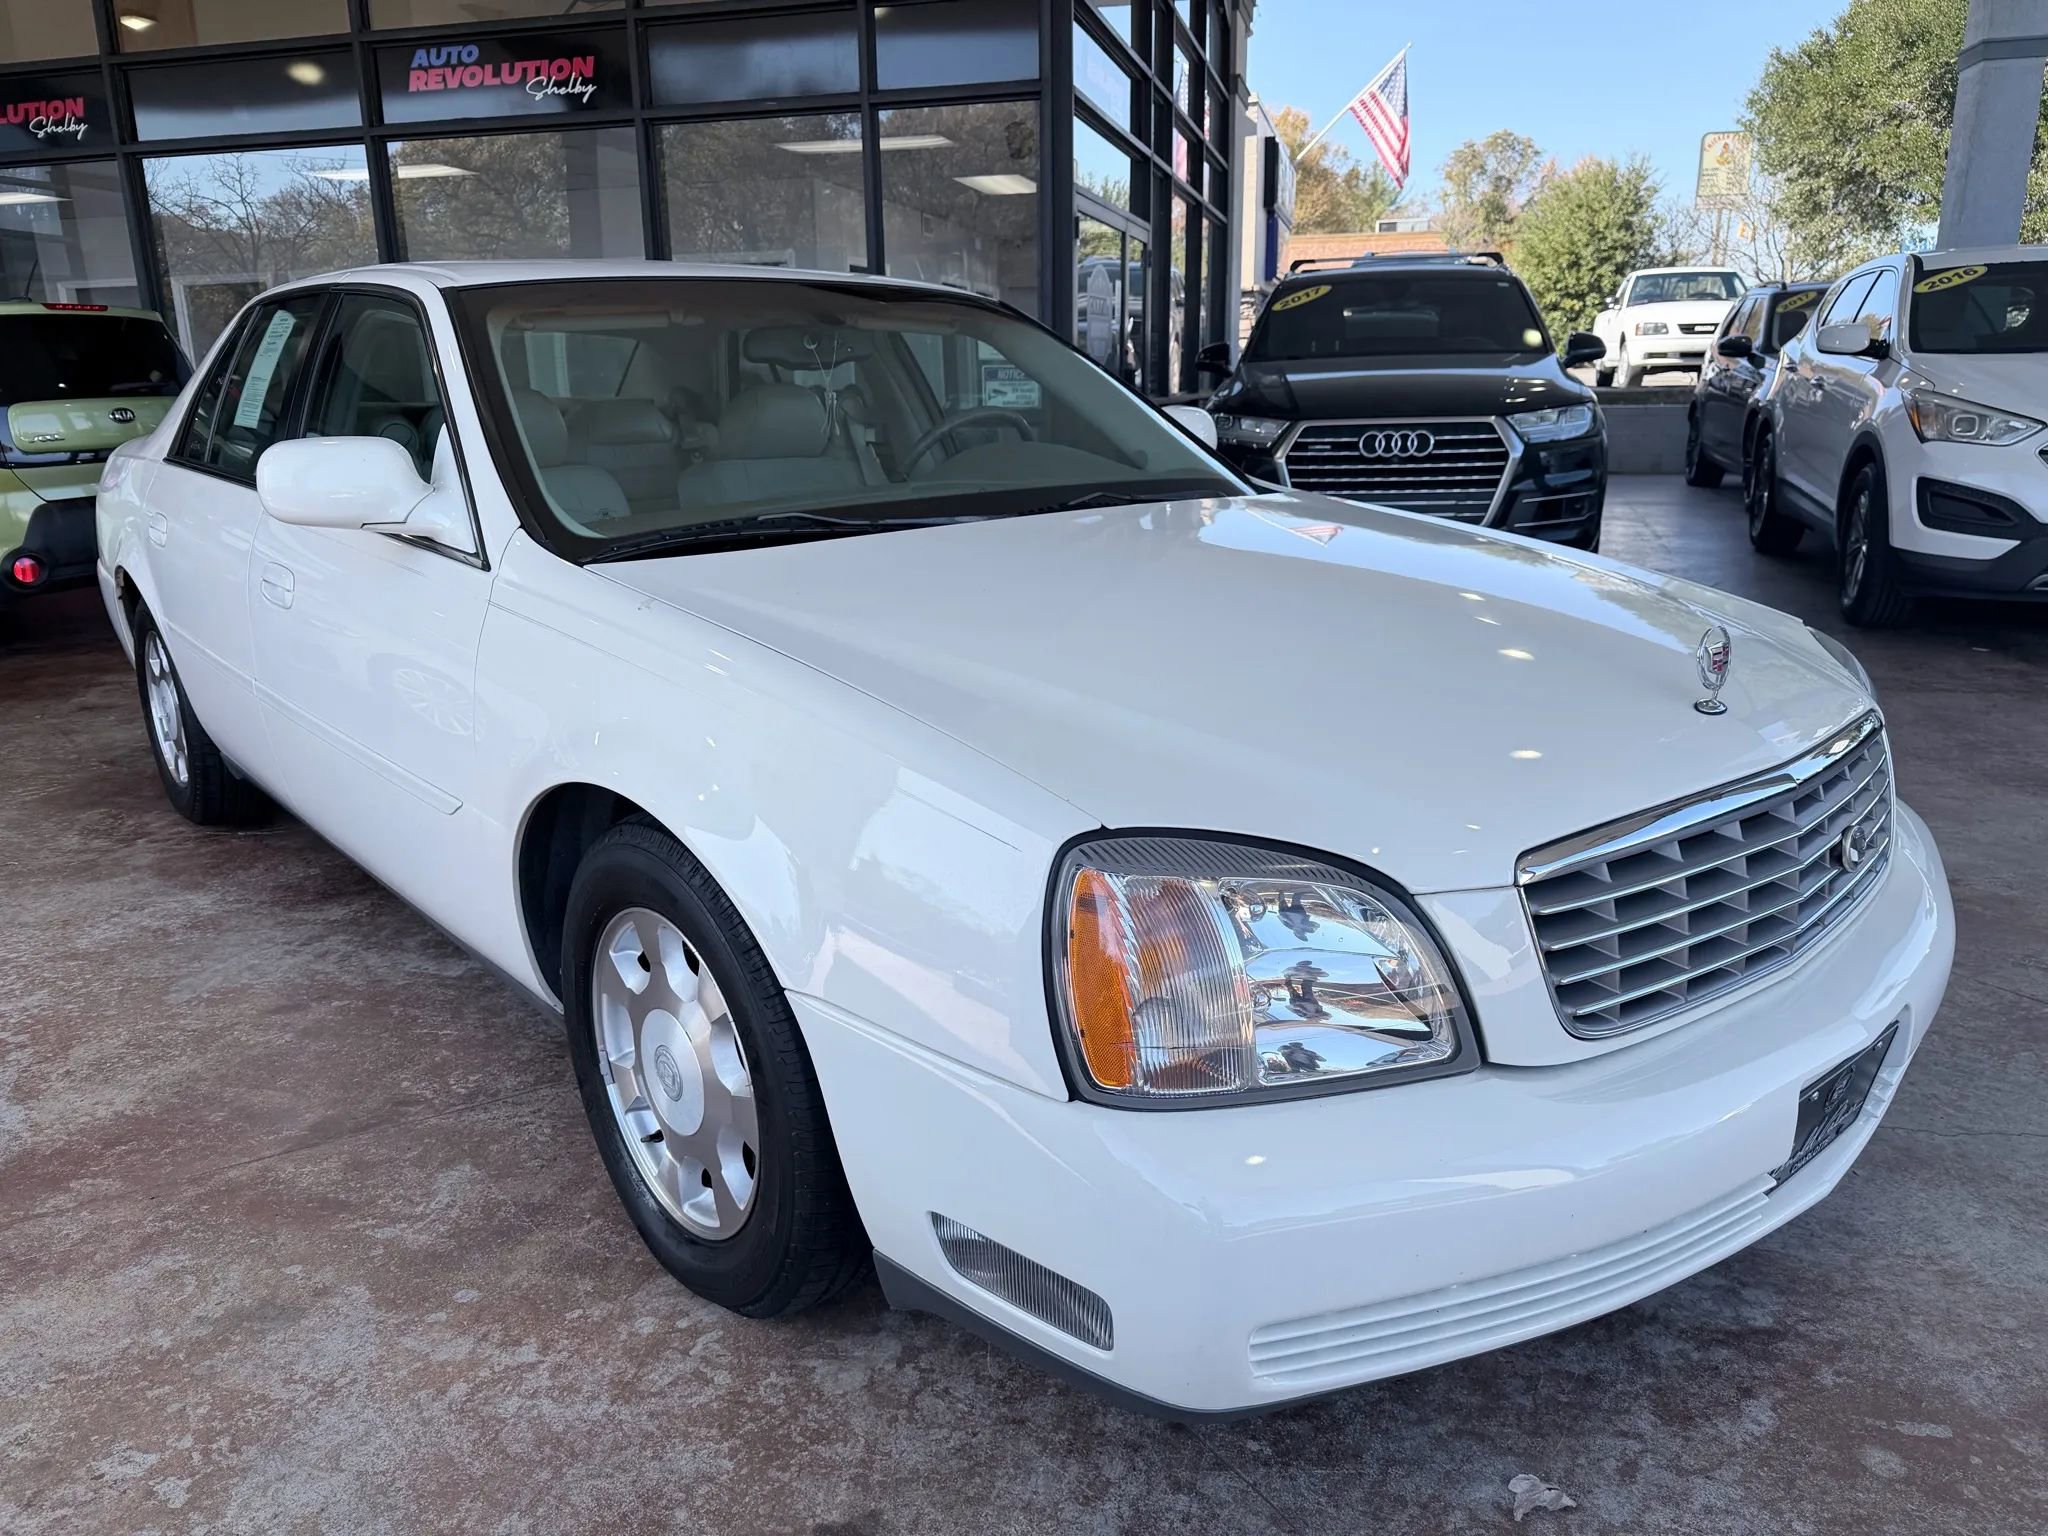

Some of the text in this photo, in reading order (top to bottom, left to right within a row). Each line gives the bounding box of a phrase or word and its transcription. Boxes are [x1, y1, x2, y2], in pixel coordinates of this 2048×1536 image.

[411, 44, 479, 68] AUTO
[408, 56, 594, 92] REVOLUTION
[526, 72, 597, 103] Shelby
[29, 112, 88, 140] Shelby
[1923, 268, 1978, 290] 2016
[1280, 287, 1321, 309] 2017
